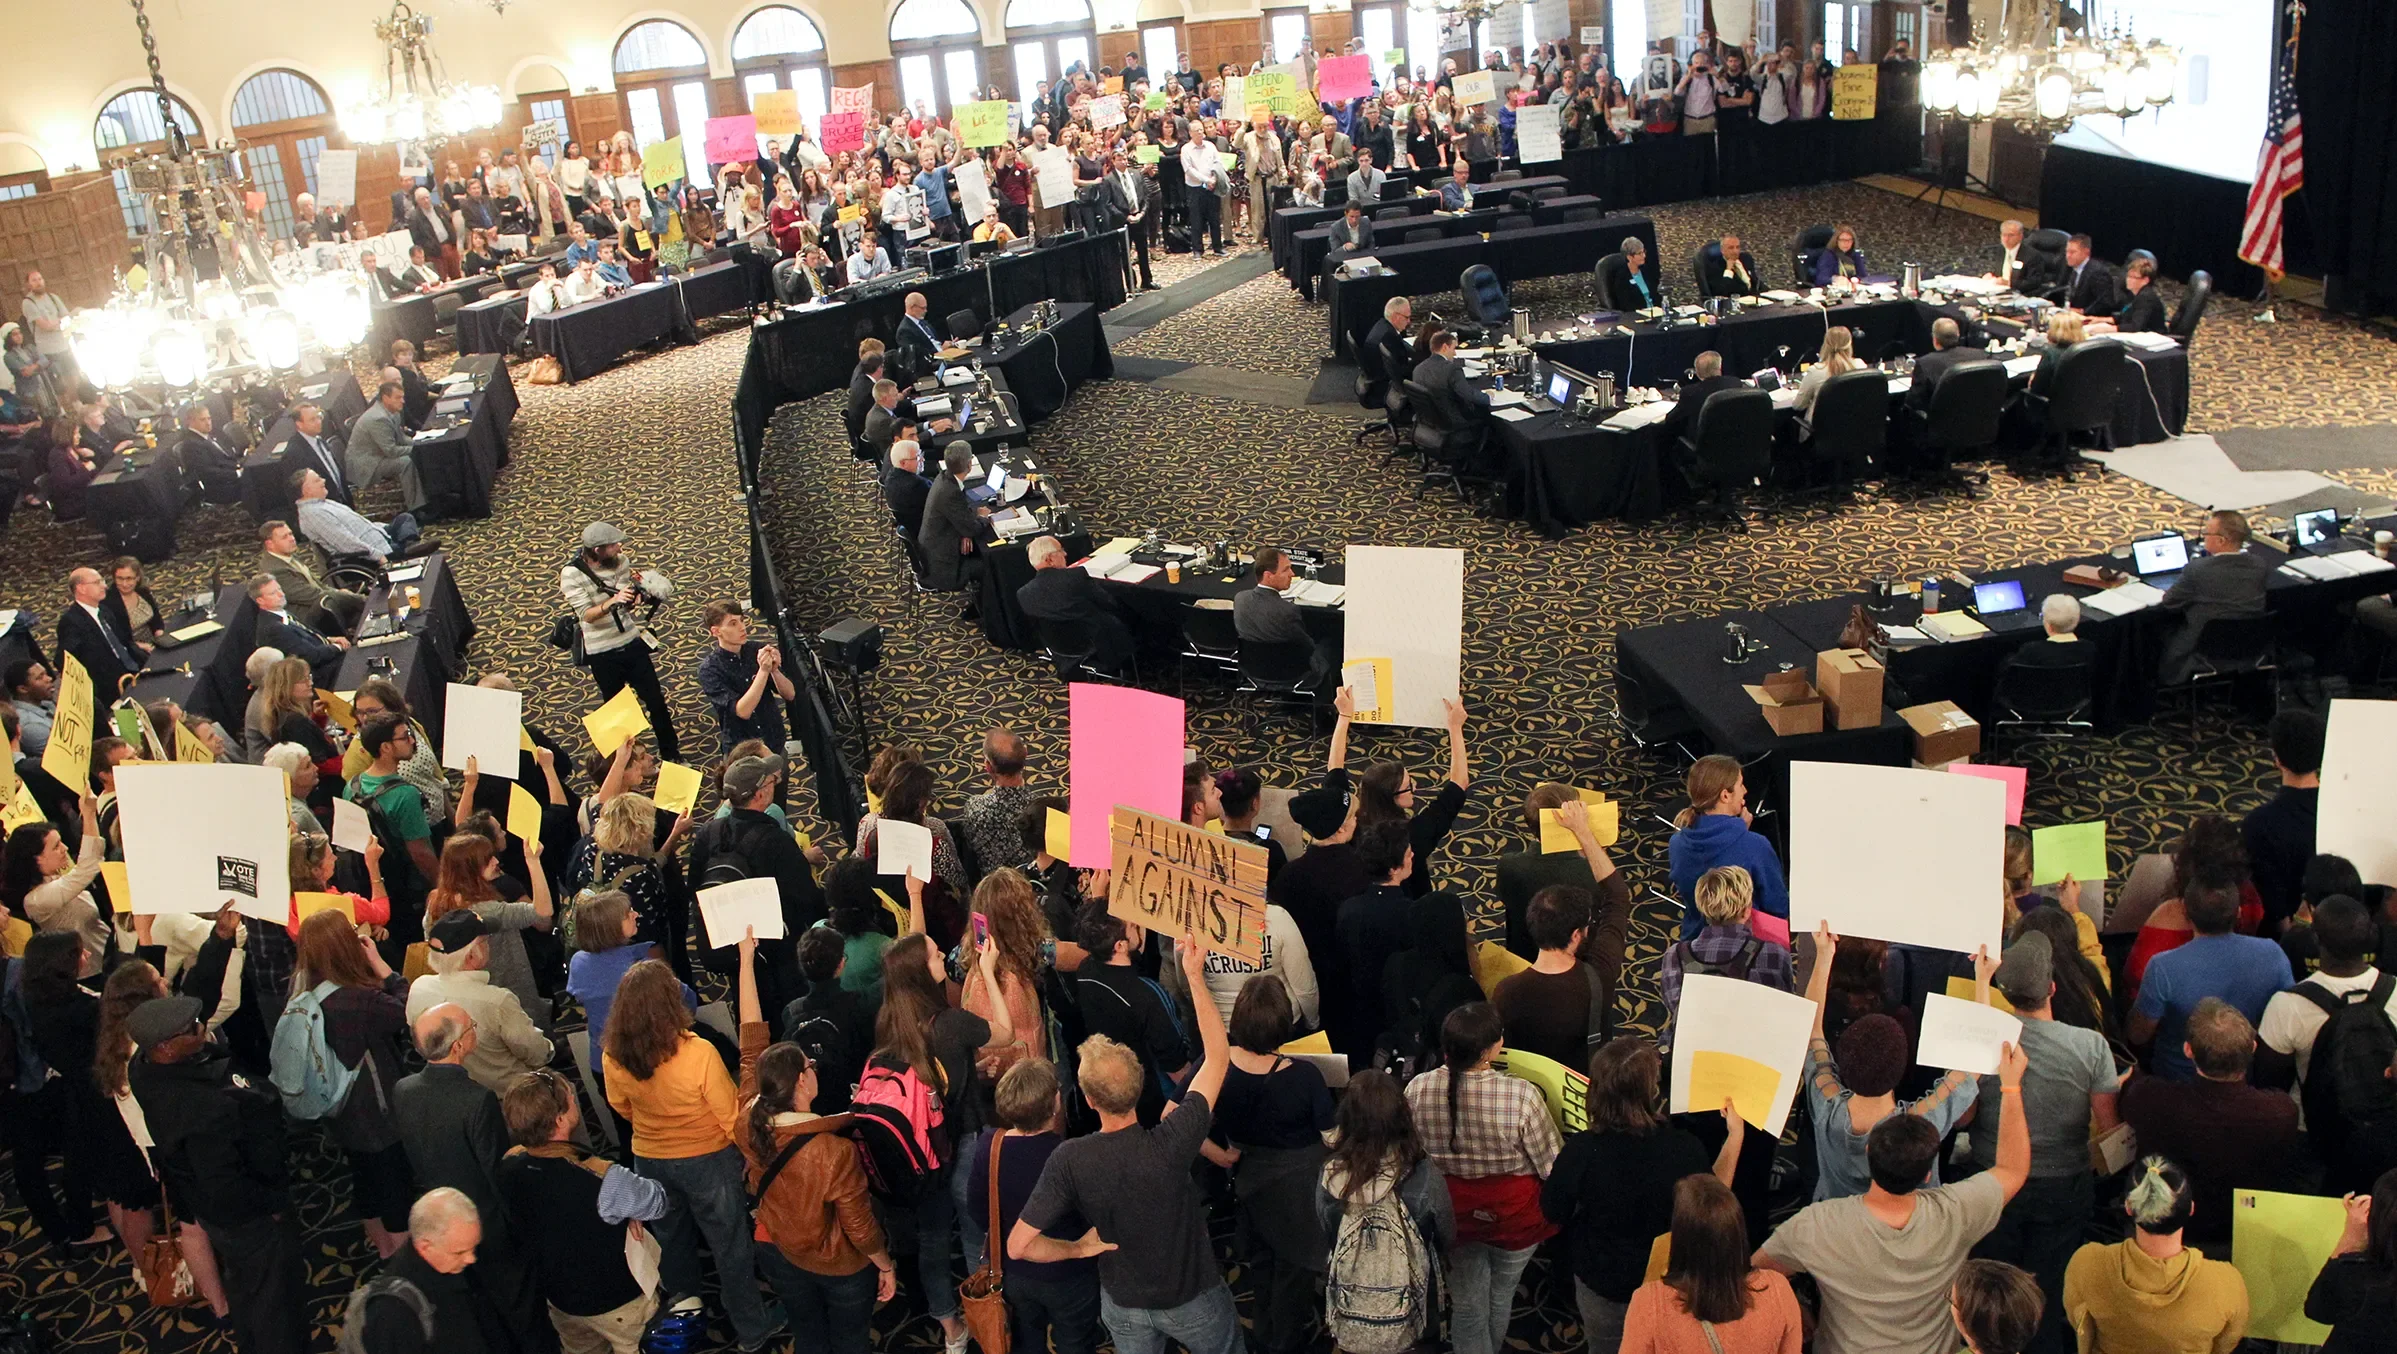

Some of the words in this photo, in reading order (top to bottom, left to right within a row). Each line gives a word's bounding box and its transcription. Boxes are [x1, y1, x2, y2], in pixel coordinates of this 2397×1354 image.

[1247, 73, 1284, 88] DEFEND
[1465, 82, 1480, 93] OUR
[822, 112, 857, 125] CUT
[972, 113, 988, 128] LIE
[822, 124, 863, 137] BRUCE
[822, 134, 863, 148] LOOSE
[65, 655, 86, 684] IOWA
[54, 711, 79, 748] NOT
[1130, 816, 1237, 886] ALUMNI
[222, 862, 255, 878] VOTE
[1115, 854, 1254, 948] AGAINST
